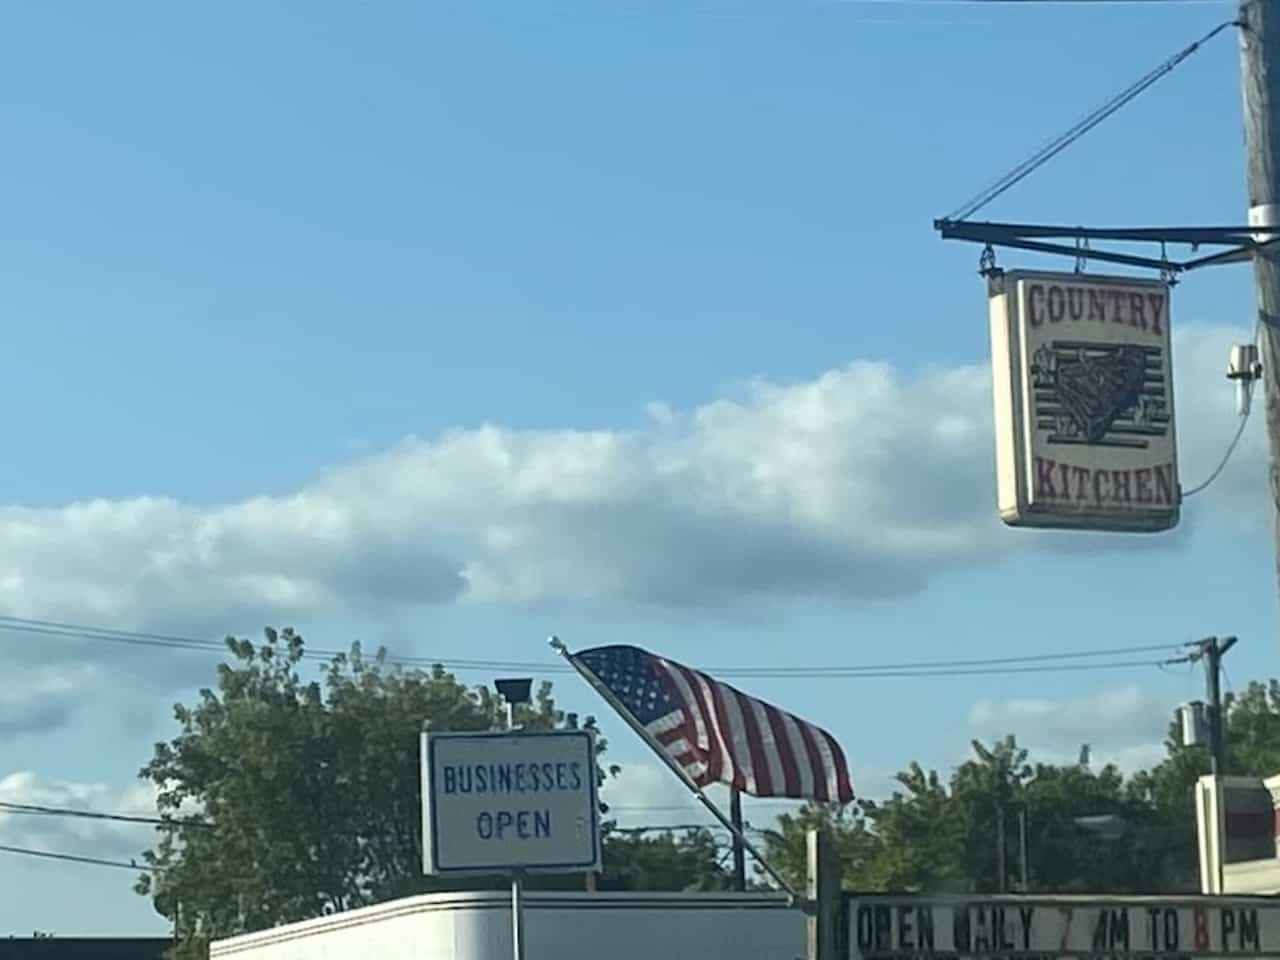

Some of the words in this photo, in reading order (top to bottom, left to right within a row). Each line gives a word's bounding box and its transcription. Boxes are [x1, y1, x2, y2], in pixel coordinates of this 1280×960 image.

[1028, 284, 1165, 336] COUNTRY
[1034, 456, 1173, 505] KITCHEN
[444, 762, 581, 794] BUSINESSES
[477, 811, 551, 839] OPEN
[857, 905, 934, 950] OPEN
[1093, 907, 1130, 951] AM
[1148, 907, 1179, 951] TO
[1222, 907, 1261, 951] PM
